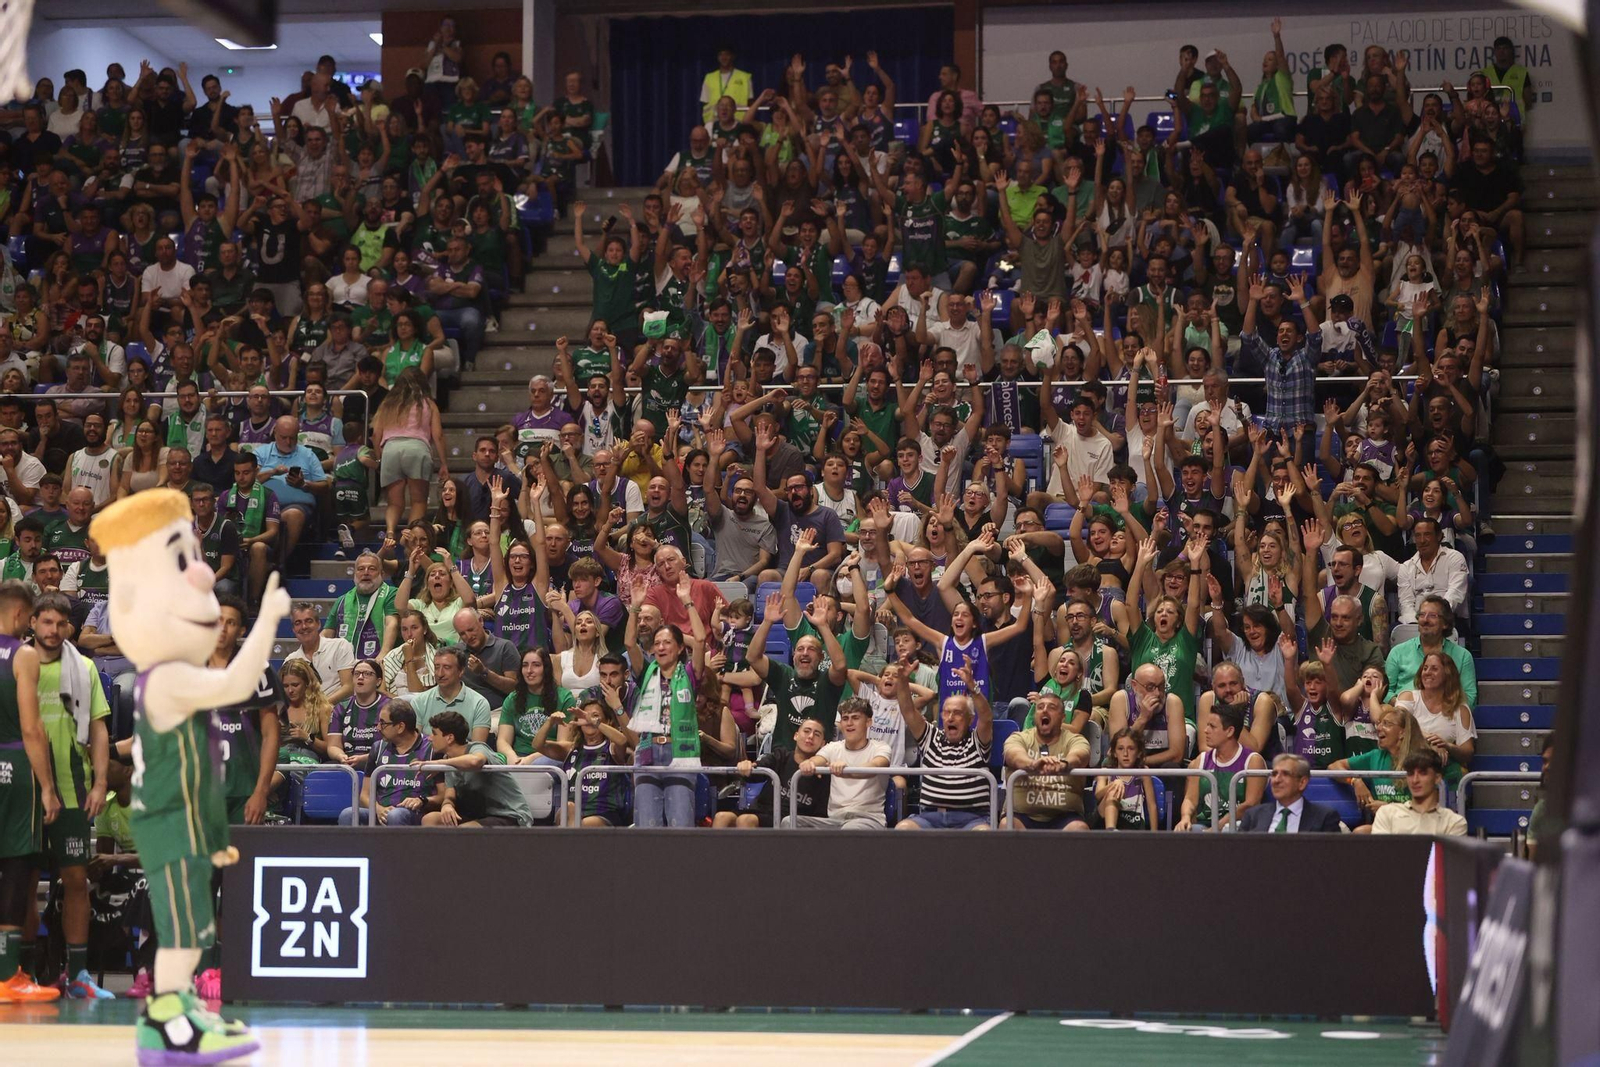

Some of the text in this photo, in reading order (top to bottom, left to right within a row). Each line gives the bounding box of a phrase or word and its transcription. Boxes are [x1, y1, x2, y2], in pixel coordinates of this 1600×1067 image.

[1350, 14, 1552, 44] PALACIO DE DEPORTES
[1286, 47, 1322, 75] OSÉ
[1454, 44, 1552, 71] CARENA
[1001, 381, 1016, 436] aloncest
[80, 470, 103, 481] Unicaja
[659, 535, 675, 545] caja
[572, 545, 594, 553] Unicaj
[509, 606, 535, 616] Unicaja
[502, 623, 530, 632] málaga
[219, 721, 242, 733] laga
[352, 727, 378, 735] Fundació
[1302, 746, 1332, 756] málaga
[392, 778, 421, 788] Unicaja
[569, 785, 600, 794] maga
[1026, 791, 1067, 806] GAME
[281, 876, 343, 914] DA
[280, 921, 340, 958] ZN
